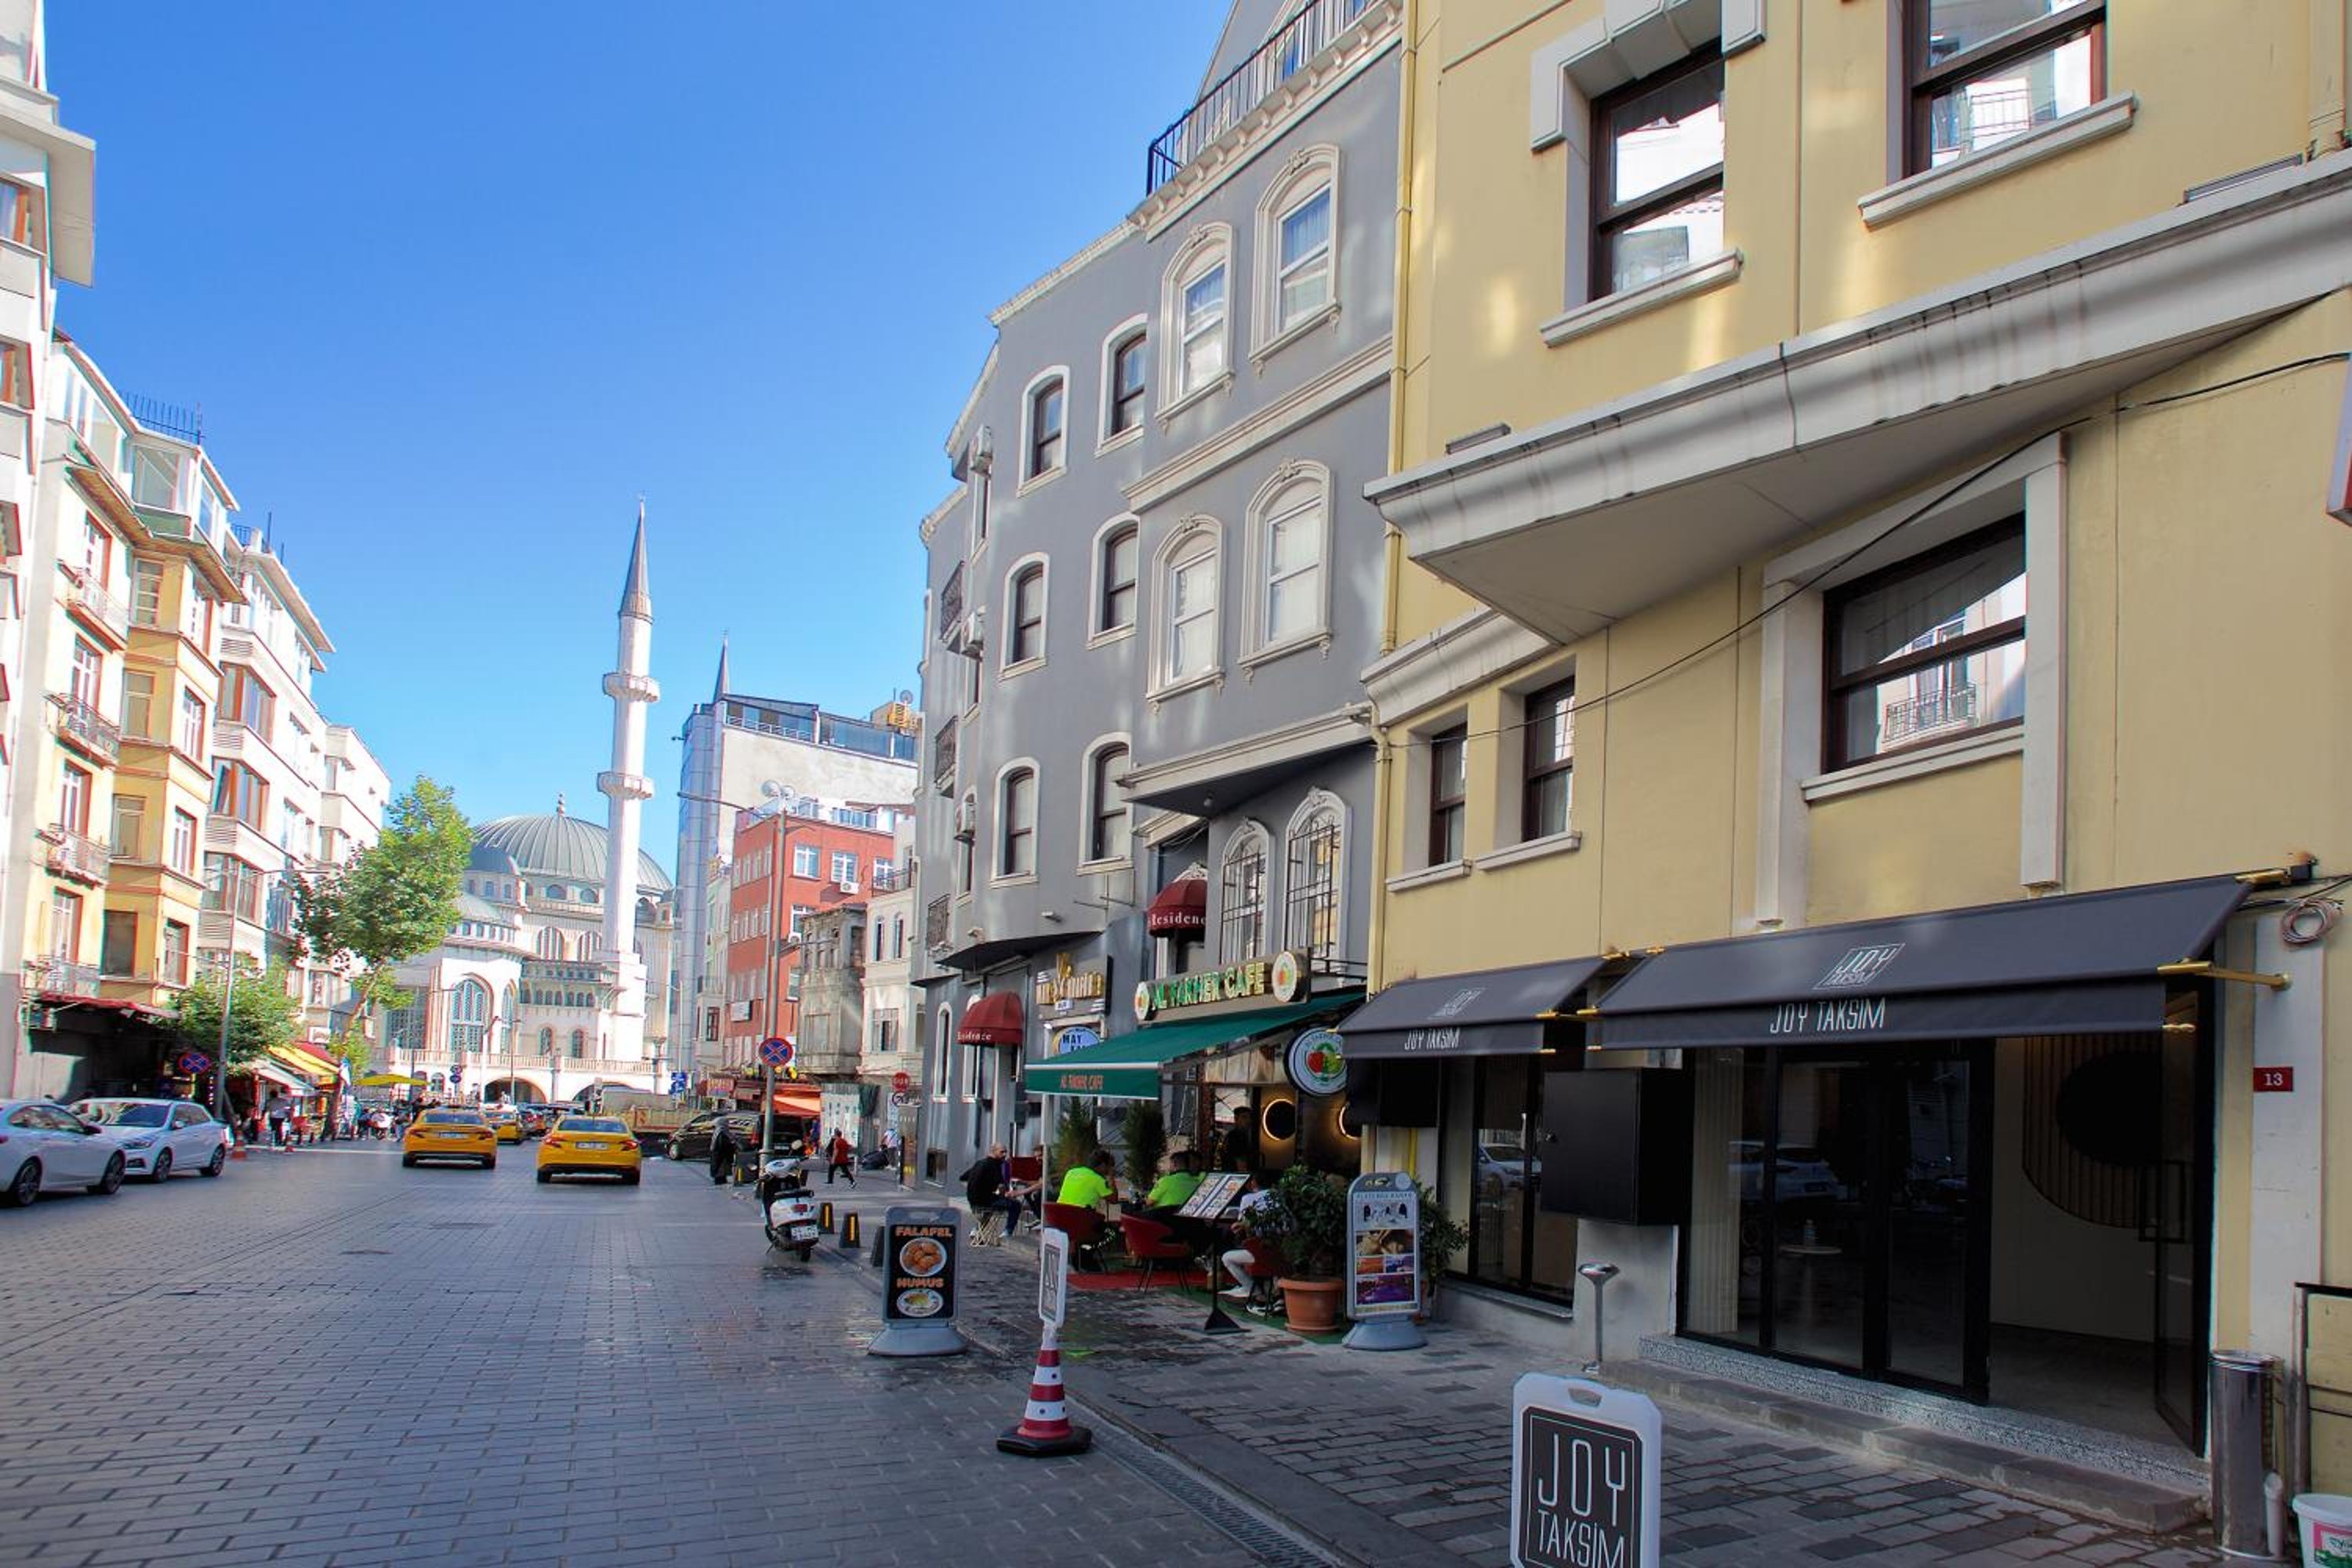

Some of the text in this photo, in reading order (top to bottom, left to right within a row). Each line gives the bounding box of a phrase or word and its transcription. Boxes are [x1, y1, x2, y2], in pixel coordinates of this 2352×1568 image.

[1835, 947, 1897, 975] JOY
[1225, 961, 1265, 1000] CAFE
[1769, 996, 1886, 1034] JOY TAKSIM
[1404, 1029, 1425, 1051] JOY
[2263, 1073, 2284, 1086] 13
[895, 1226, 953, 1237] FALAFEL
[896, 1277, 945, 1288] HUMUS
[1537, 1432, 1626, 1528] JOY
